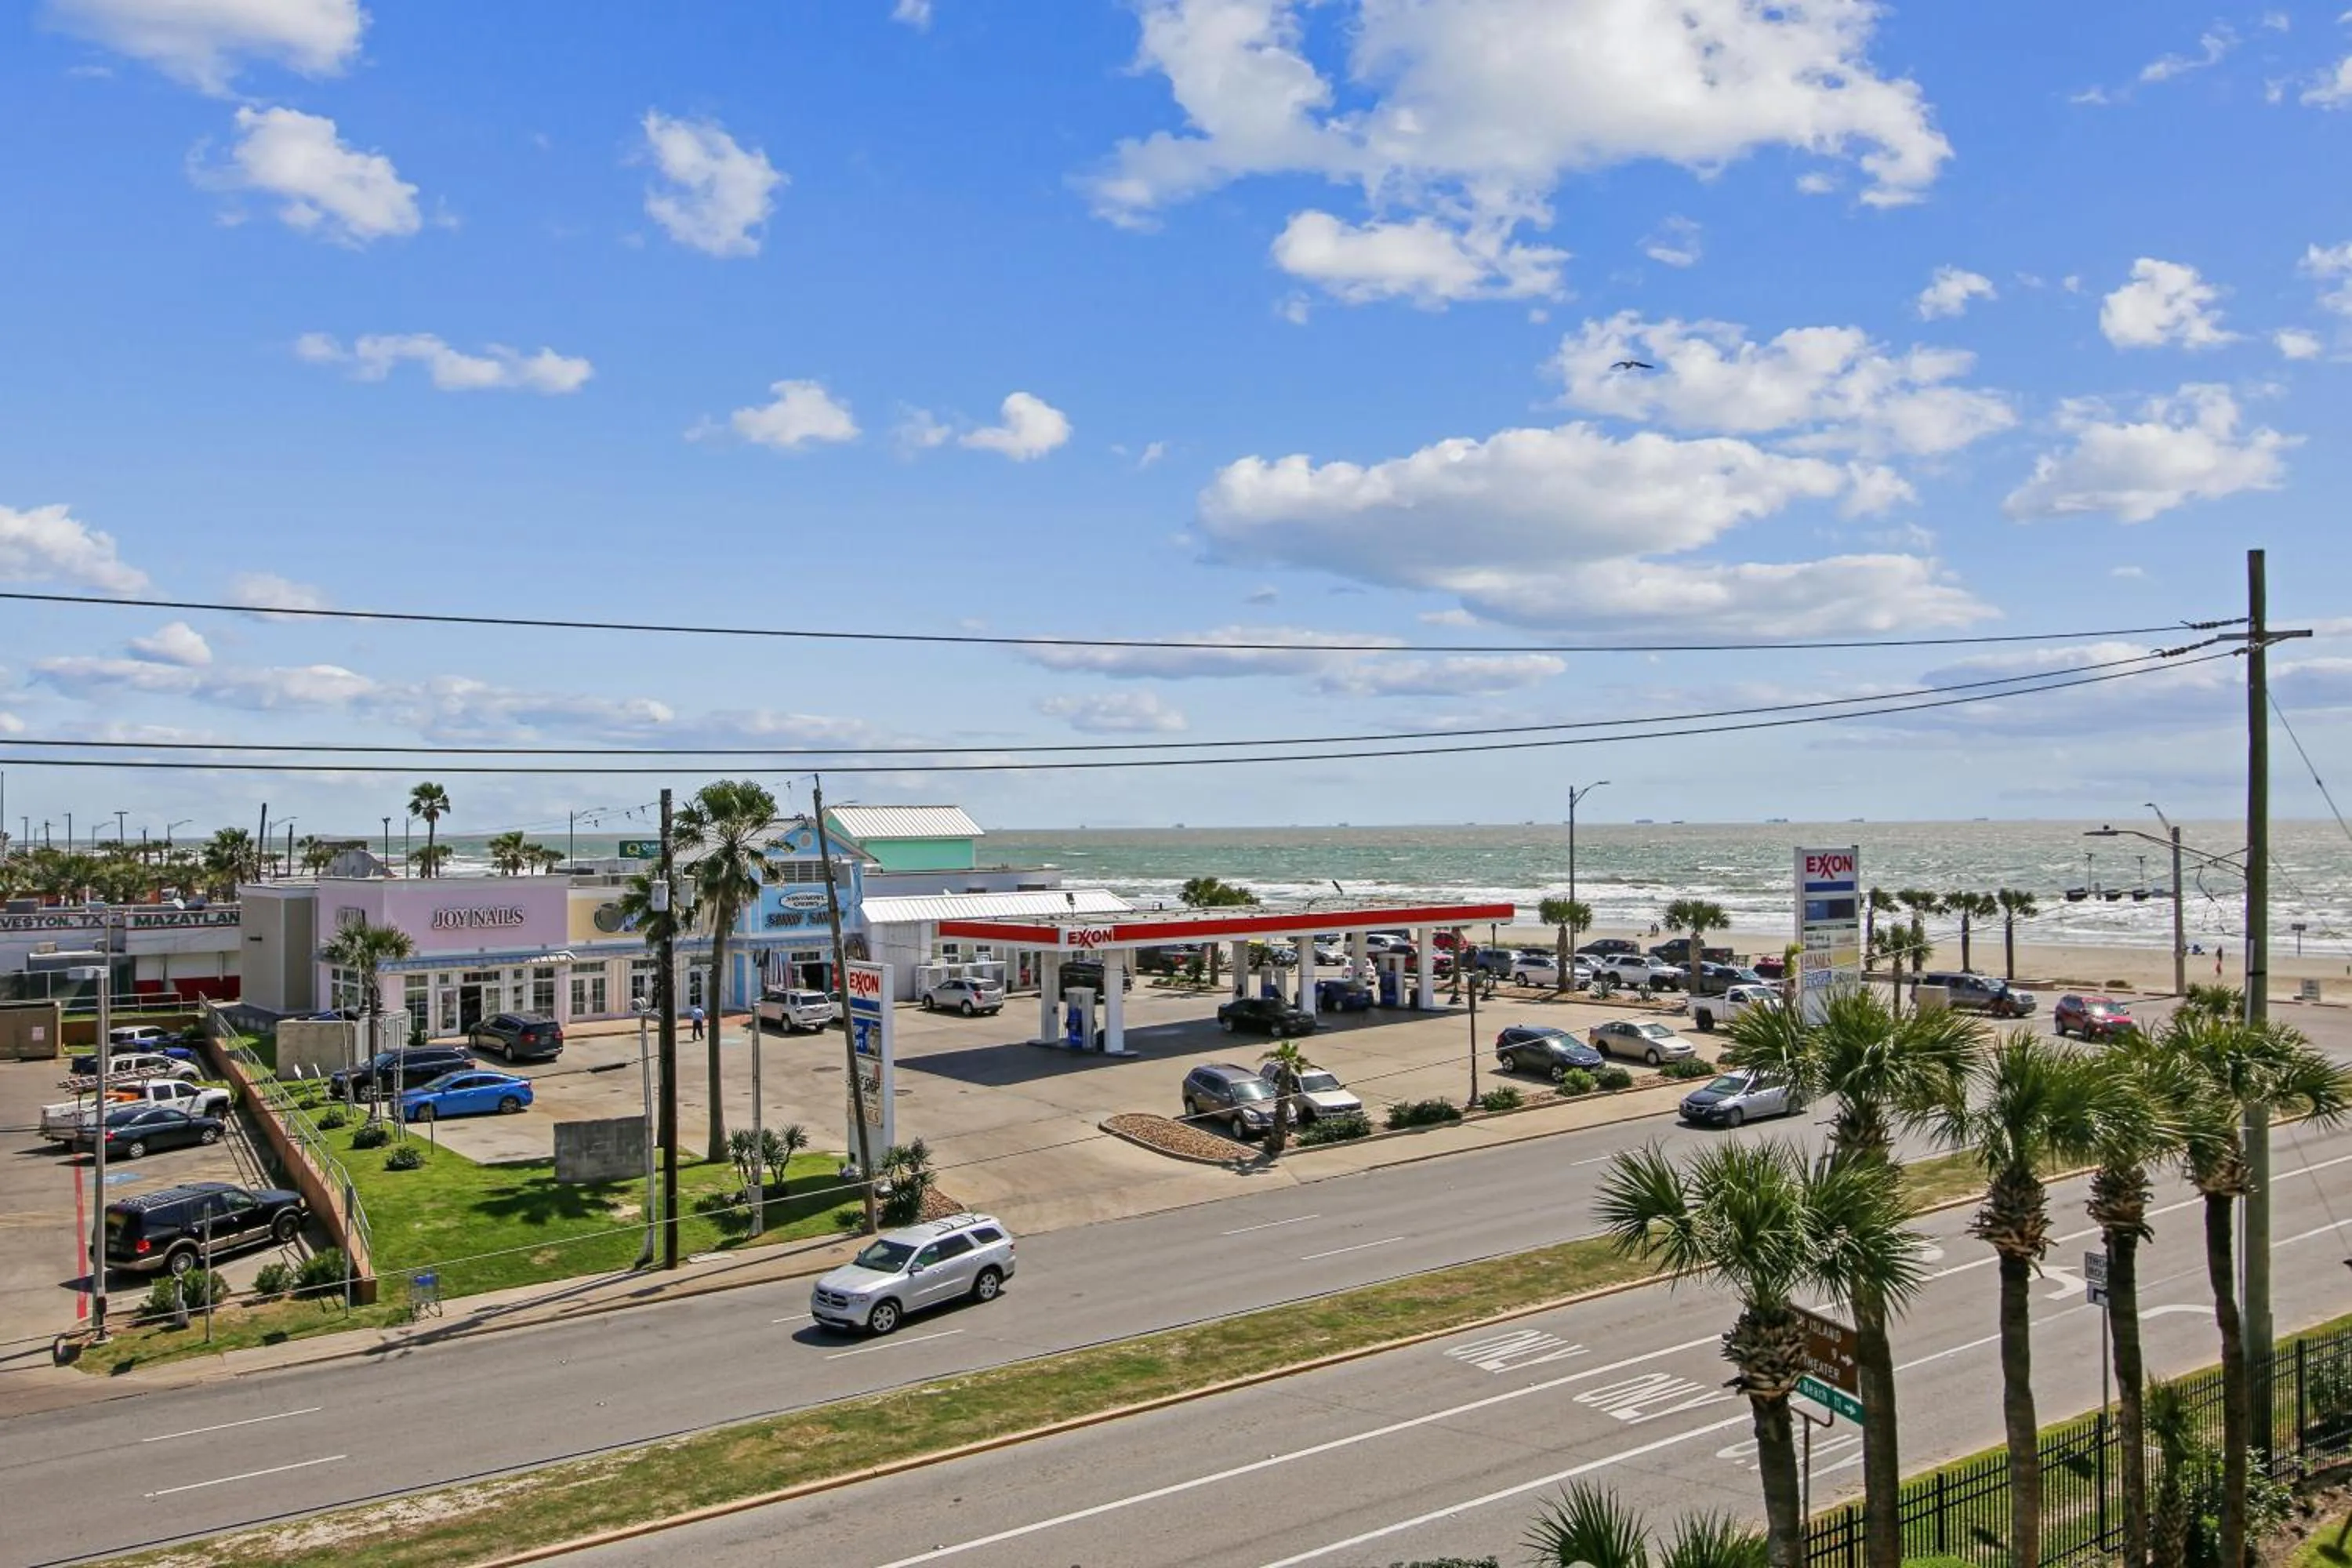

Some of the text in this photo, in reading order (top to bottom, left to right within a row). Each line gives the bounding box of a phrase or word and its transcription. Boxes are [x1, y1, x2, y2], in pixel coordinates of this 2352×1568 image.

[1806, 853, 1853, 880] EXXON
[81, 914, 103, 926] TX
[134, 912, 240, 927] MAZATLAN
[434, 908, 524, 928] JOY NAILS
[1068, 928, 1112, 949] EXXON
[850, 971, 880, 997] EXXON
[1809, 1320, 1842, 1342] ISLAND
[1443, 1330, 1590, 1374] ONLY
[1572, 1372, 1736, 1425] ONLY
